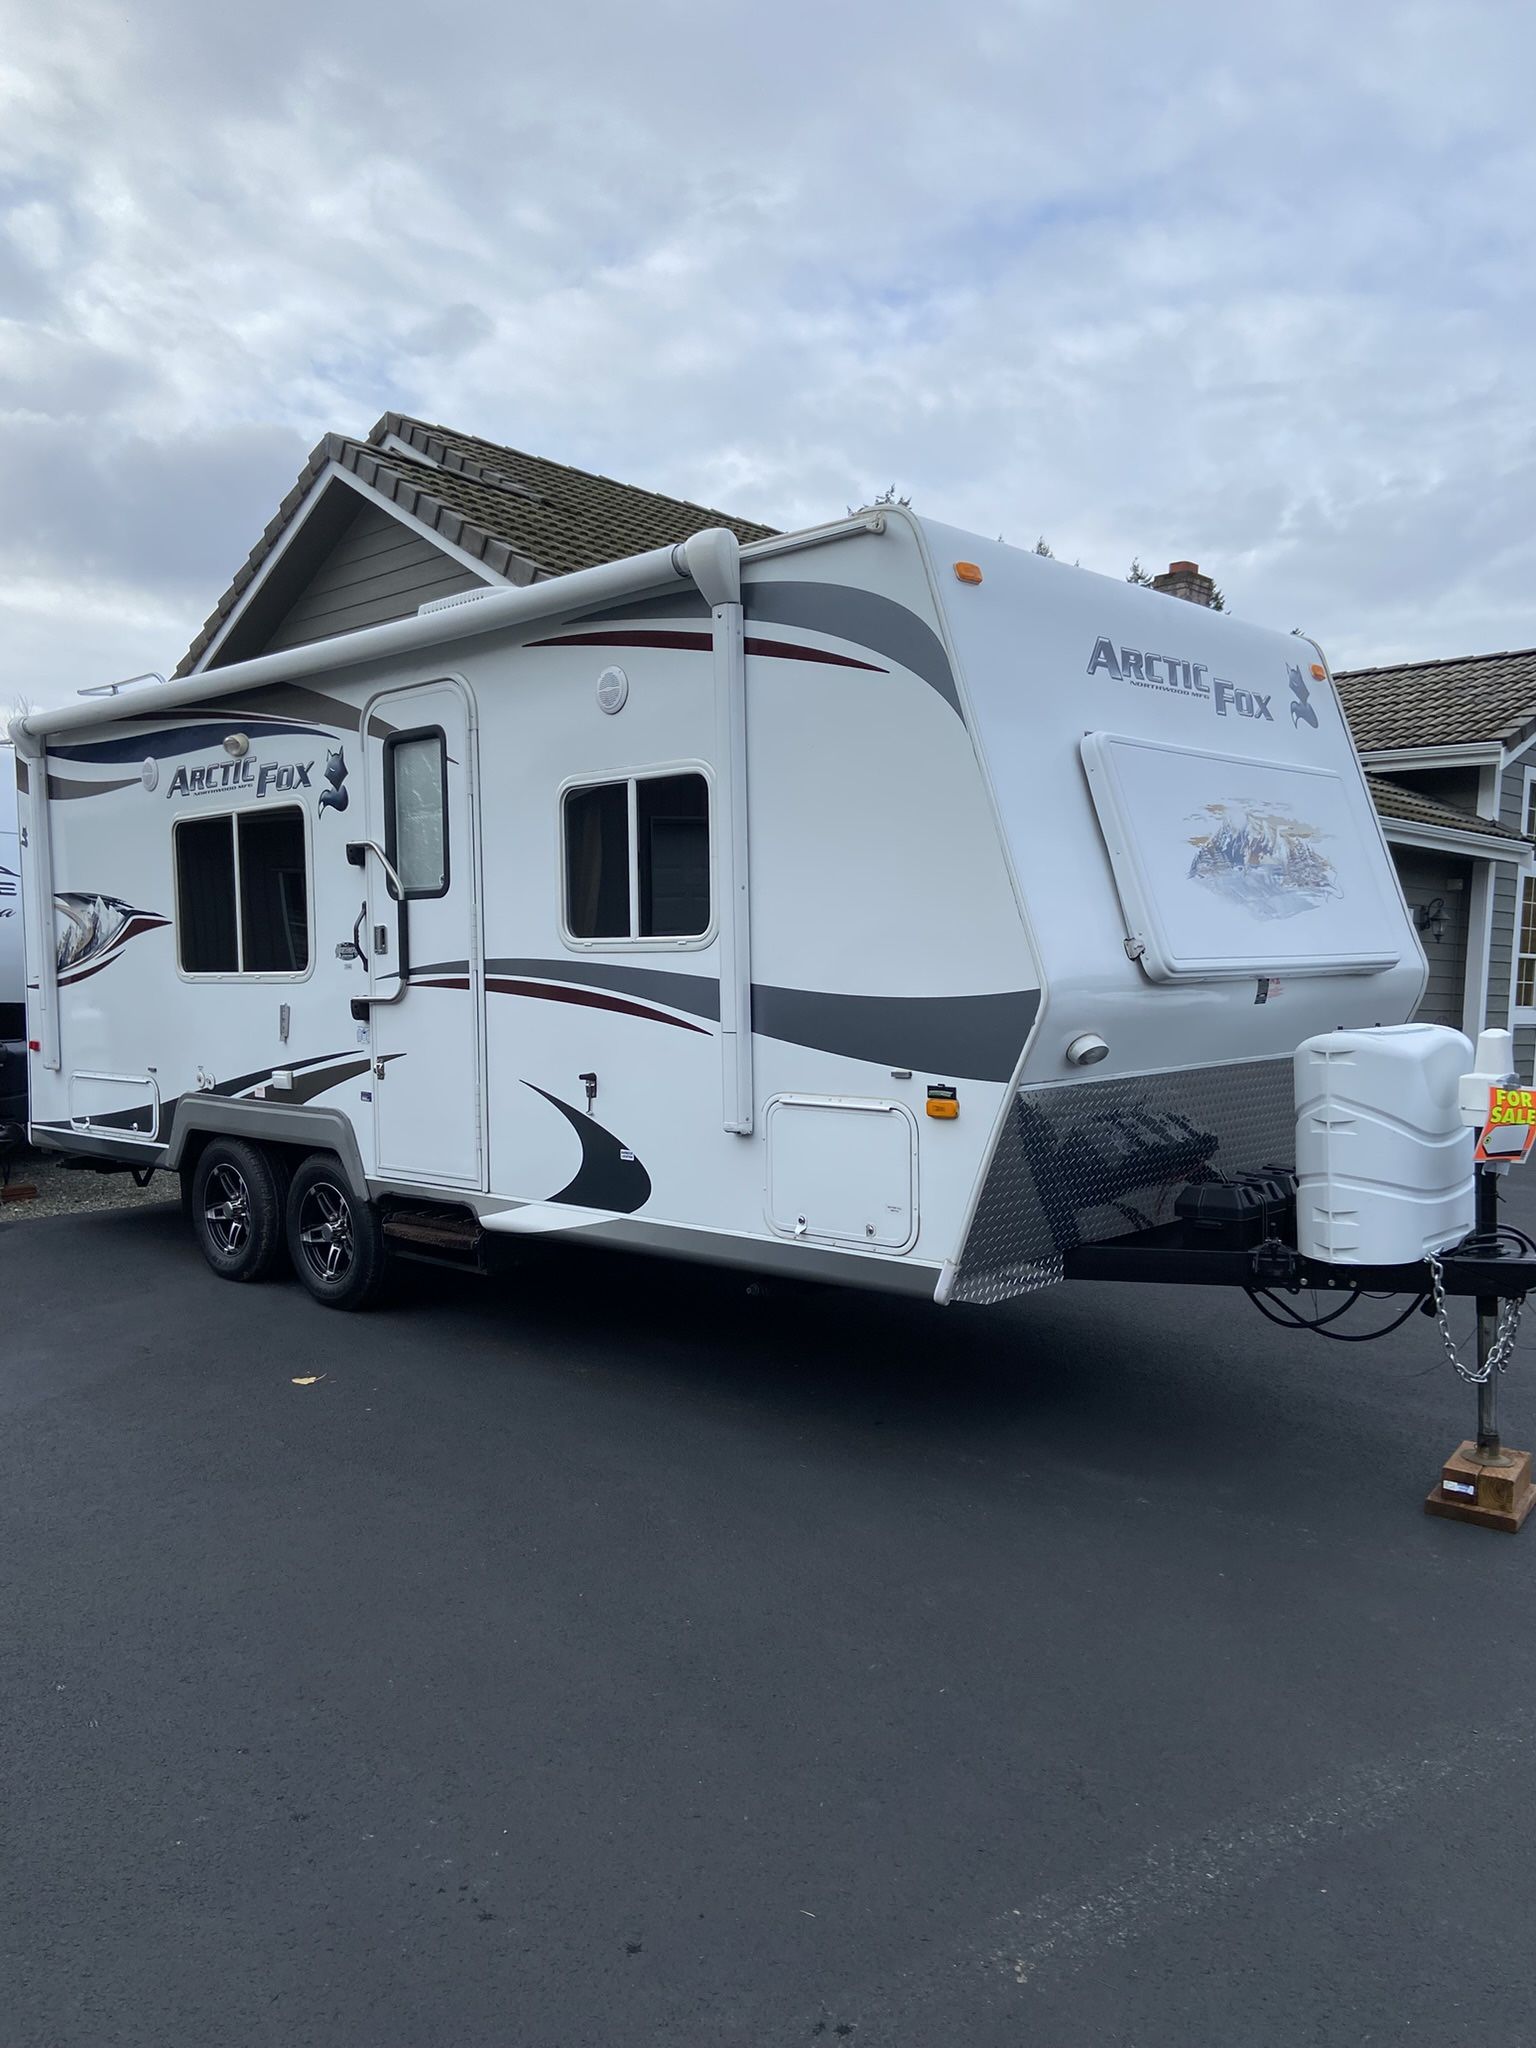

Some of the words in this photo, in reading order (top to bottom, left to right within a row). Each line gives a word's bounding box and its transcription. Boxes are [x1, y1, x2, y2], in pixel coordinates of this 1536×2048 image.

[1086, 636, 1211, 693] ARCTIC
[1213, 678, 1274, 721] FOX
[1129, 679, 1190, 697] NORTHWOOD
[1190, 690, 1210, 700] MFG
[166, 756, 257, 799] ARCTIC
[256, 761, 315, 798] FOX
[1496, 1089, 1533, 1107] FOR
[1490, 1106, 1536, 1125] SALE
